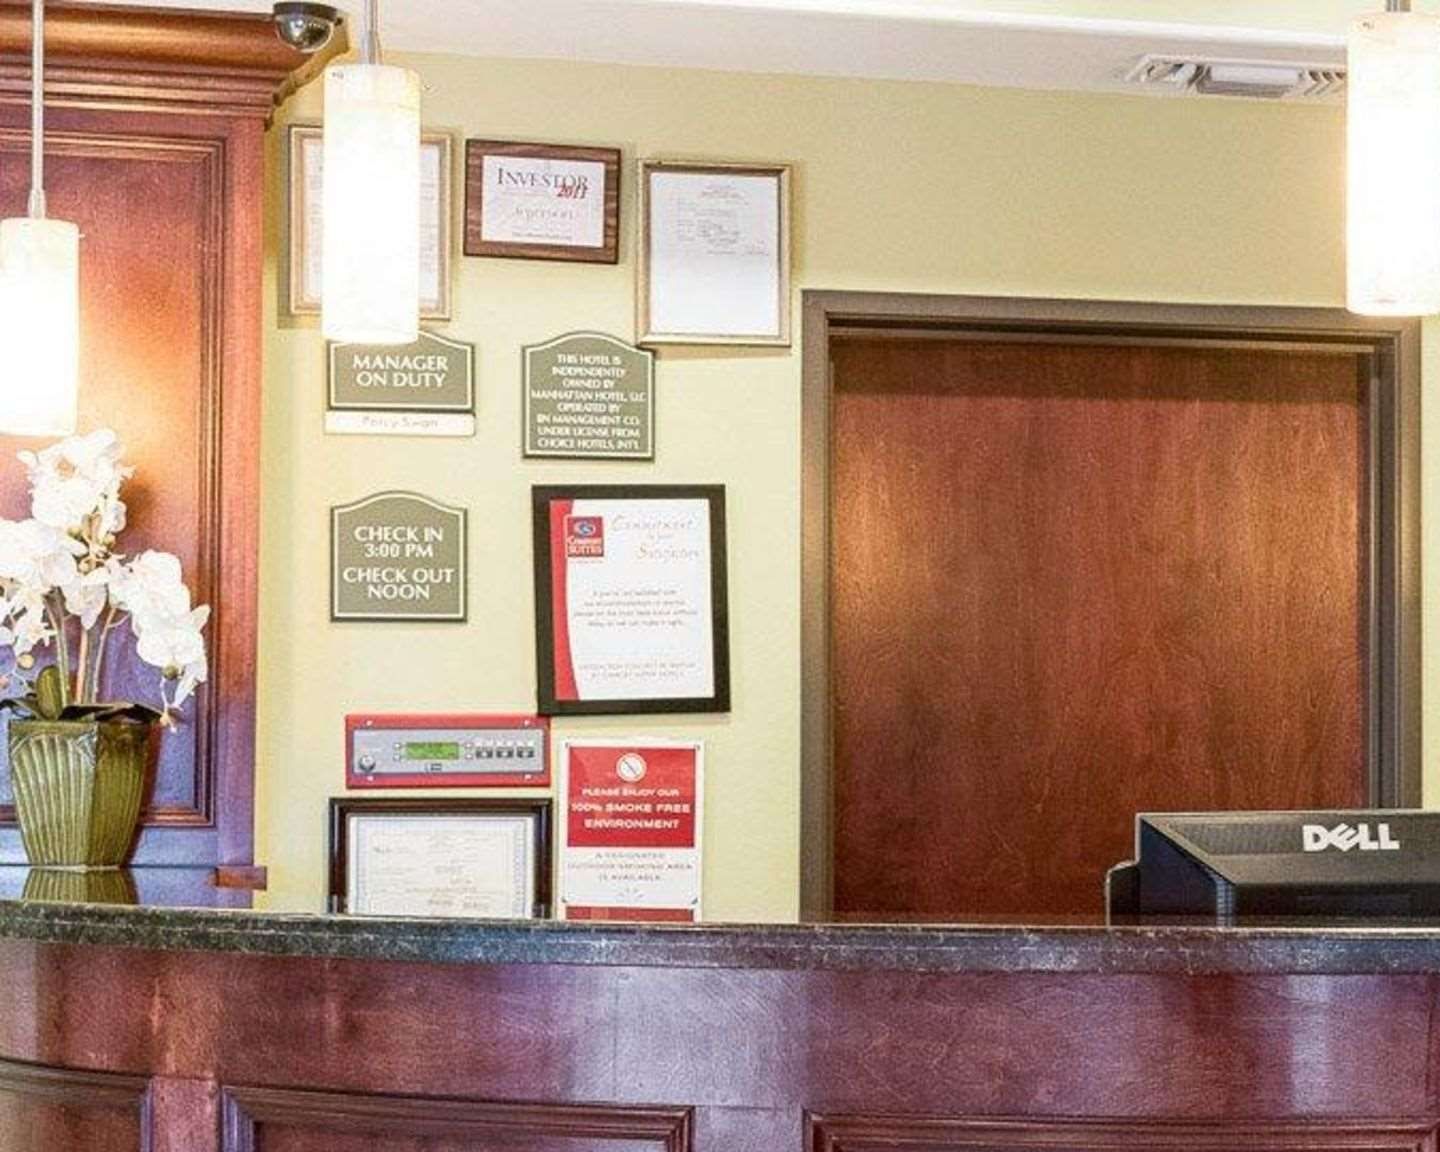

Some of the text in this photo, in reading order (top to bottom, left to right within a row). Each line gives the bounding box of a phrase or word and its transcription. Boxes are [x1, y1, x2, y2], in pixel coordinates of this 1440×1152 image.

[497, 167, 588, 190] INVESTOR
[353, 354, 449, 371] MANAGER
[557, 353, 622, 365] THIS HOTEL IS
[552, 366, 626, 378] INDEPENDENTLY
[356, 371, 447, 388] ON DUTY
[562, 378, 615, 389] OWNED BY
[531, 390, 593, 401] MANHATTAN
[557, 402, 622, 413] OPERATED BY
[552, 414, 621, 425] MANAGEMENT
[537, 426, 641, 439] UNDER LICENSE FROM
[537, 438, 575, 448] CHOICE
[354, 526, 443, 542] CHECK IN
[364, 543, 433, 558] 3:00 PM
[343, 567, 455, 583] CHECK OUT
[367, 584, 430, 600] NOON
[582, 788, 680, 797] PLEASE ENJOY OUR
[571, 803, 691, 813] 100% SMOKE FREE
[583, 818, 680, 829] ENVIRONMENT
[1302, 823, 1400, 852] DELL
